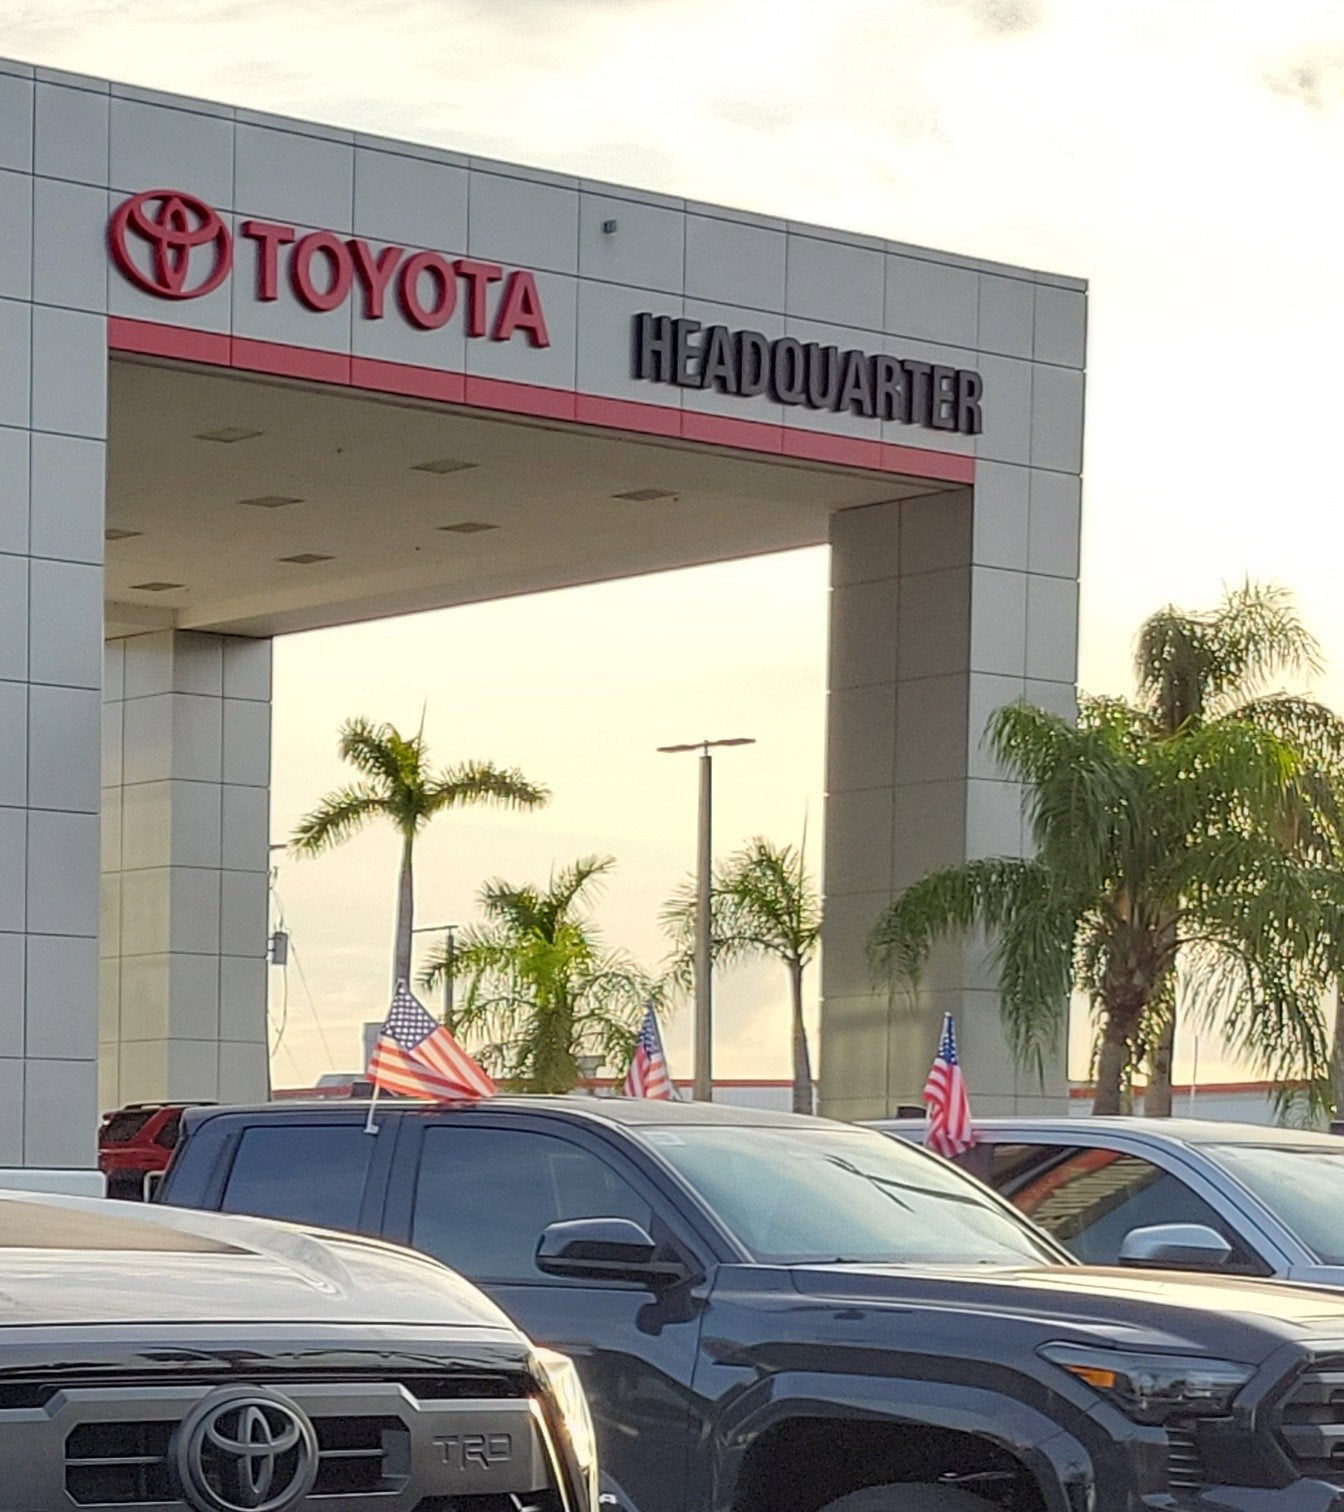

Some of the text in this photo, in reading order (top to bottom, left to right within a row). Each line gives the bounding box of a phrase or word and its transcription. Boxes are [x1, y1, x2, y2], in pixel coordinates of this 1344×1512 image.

[243, 220, 550, 348] TOYOTA
[630, 312, 984, 435] HEADQUARTER
[432, 1432, 512, 1470] TRD
